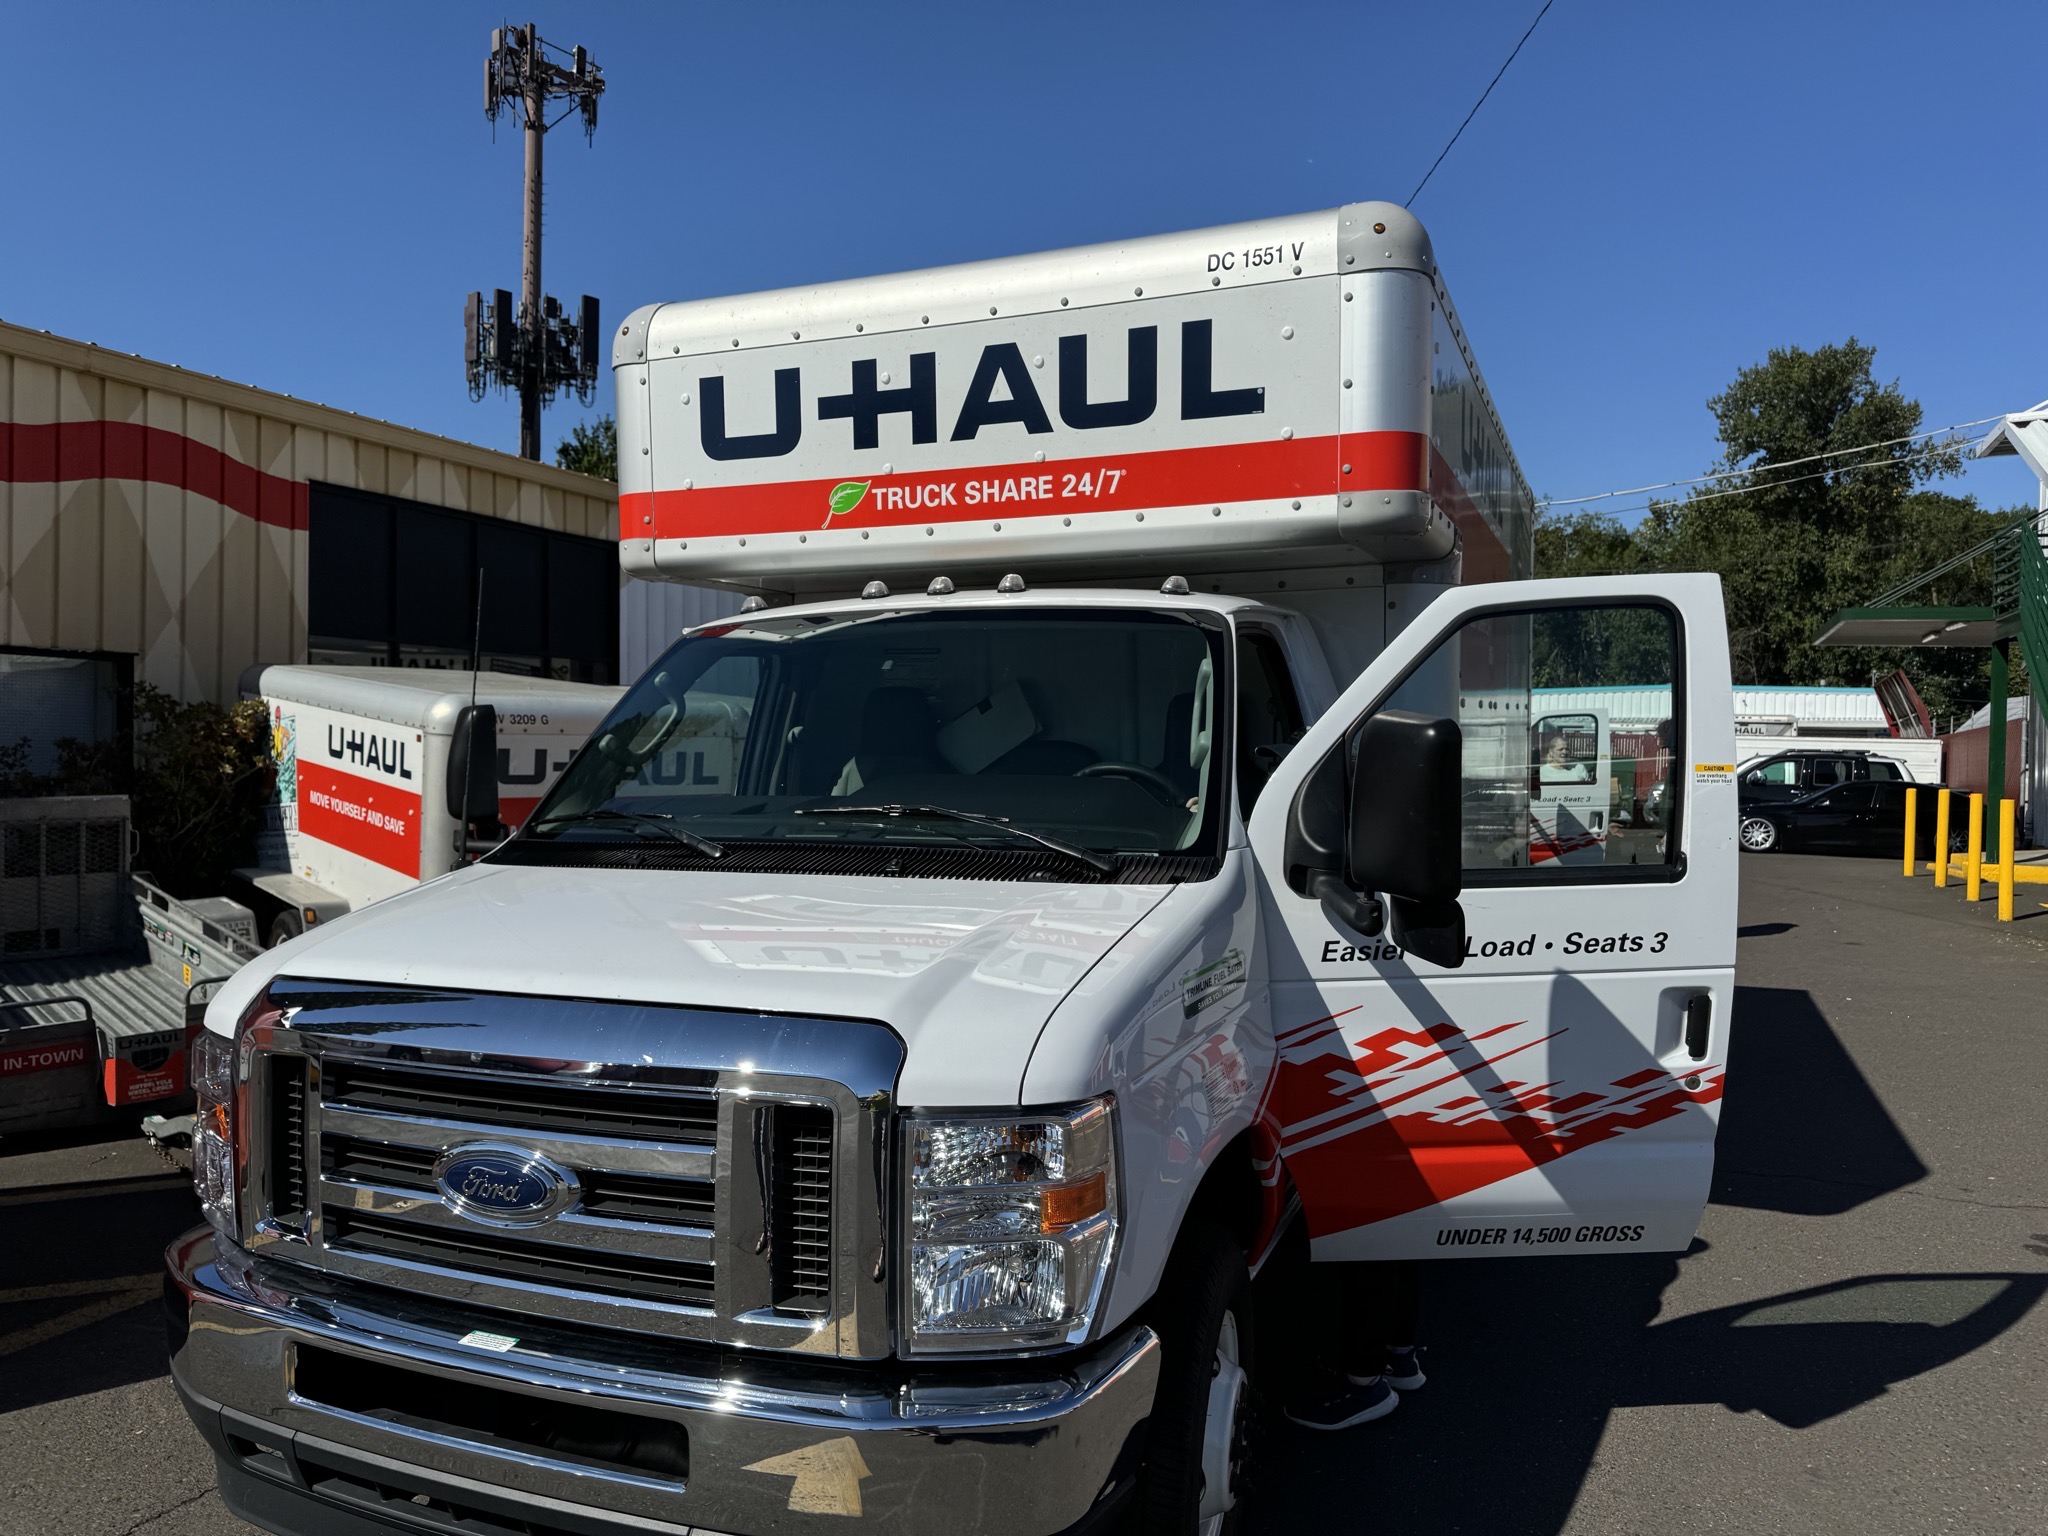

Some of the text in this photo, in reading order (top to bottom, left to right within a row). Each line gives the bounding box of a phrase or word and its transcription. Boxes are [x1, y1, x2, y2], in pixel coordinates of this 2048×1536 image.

[1207, 241, 1305, 272] DC 1551 V
[699, 318, 1265, 462] U-HAUL
[872, 483, 957, 511] TRUCK
[964, 475, 1053, 505] SHARE
[510, 714, 536, 725] 3209
[540, 714, 549, 725] G
[328, 724, 412, 780] U-HAUL
[310, 790, 405, 836] MOVE YOURSELF AND SAVE
[1464, 934, 1536, 958] Load
[1563, 932, 1643, 955] Seats
[1650, 932, 1669, 953] 3
[1186, 976, 1213, 999] TRIMLINE
[1213, 970, 1227, 985] FUEL
[1197, 996, 1213, 1010] SAVES
[119, 1032, 183, 1050] U-HAUL
[3, 1048, 84, 1071] IN-TOWN
[461, 1166, 520, 1202] Ford
[1436, 1225, 1645, 1246] UNDER 14,500 GROSS
